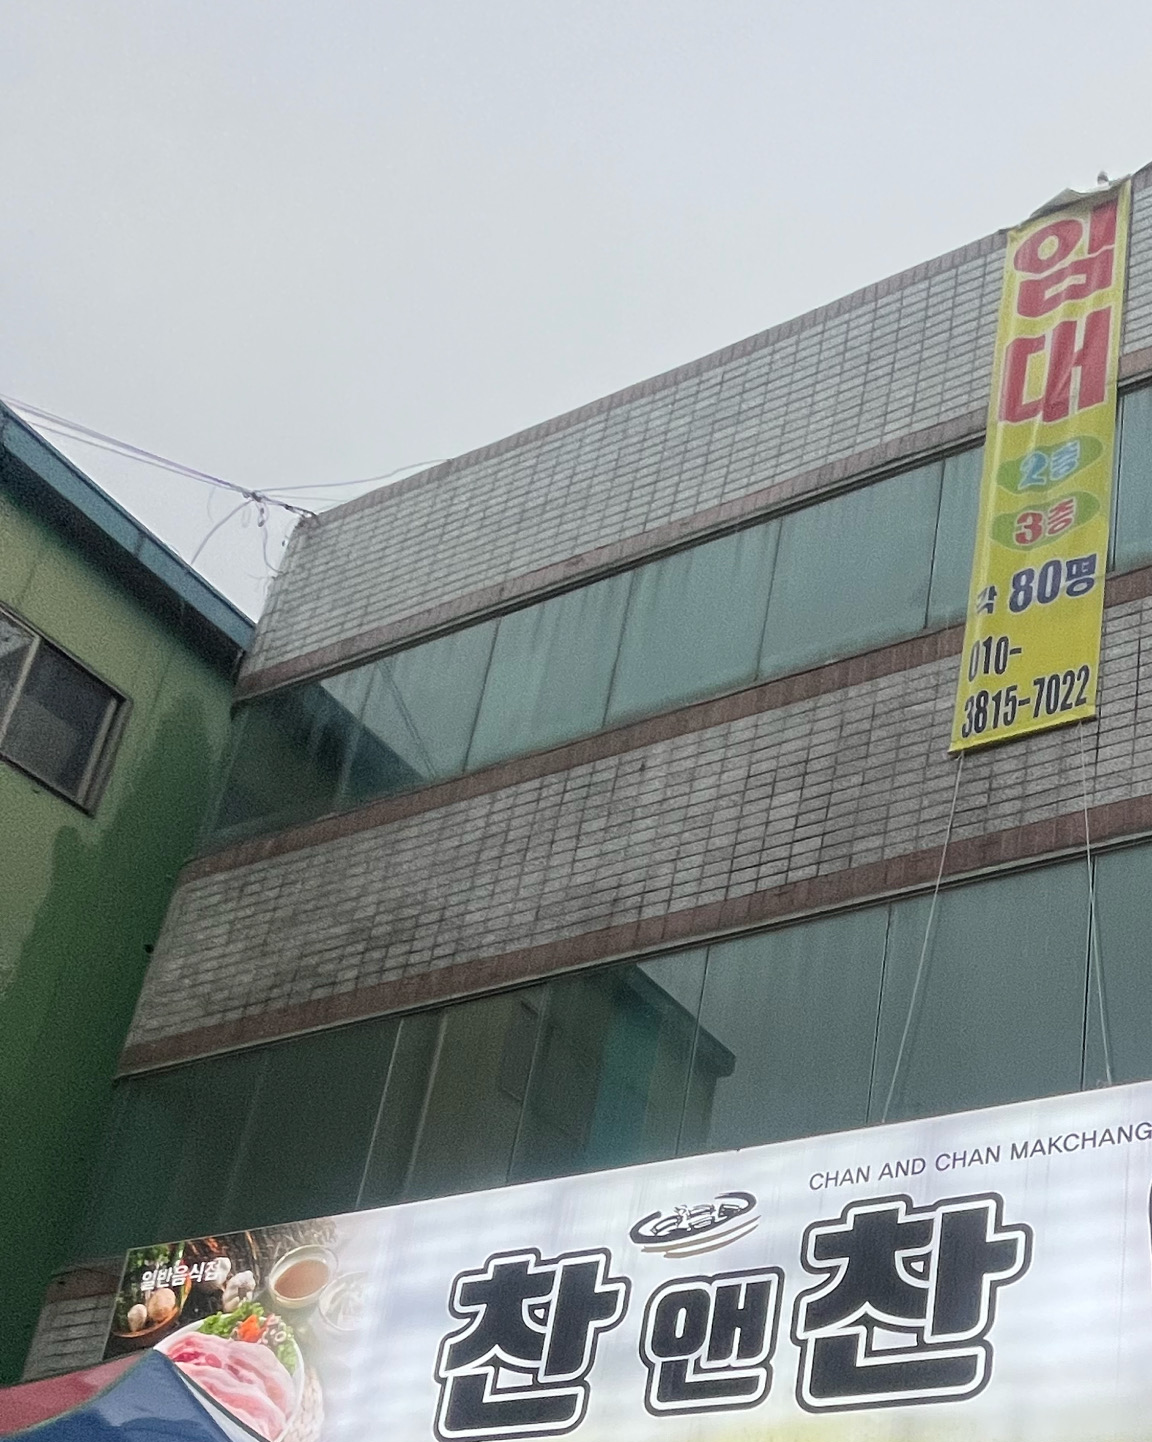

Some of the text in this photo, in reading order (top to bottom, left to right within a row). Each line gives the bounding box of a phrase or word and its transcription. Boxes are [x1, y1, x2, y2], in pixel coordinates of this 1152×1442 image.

[1018, 440, 1080, 490] 2층
[1014, 497, 1075, 545] 3층
[968, 636, 1022, 682] 010-
[961, 665, 1090, 738] 3815-7022
[809, 1165, 871, 1190] CHAN
[878, 1157, 926, 1181] AND
[935, 1145, 1001, 1172] CHAN
[141, 1261, 220, 1291] 일반음식점
